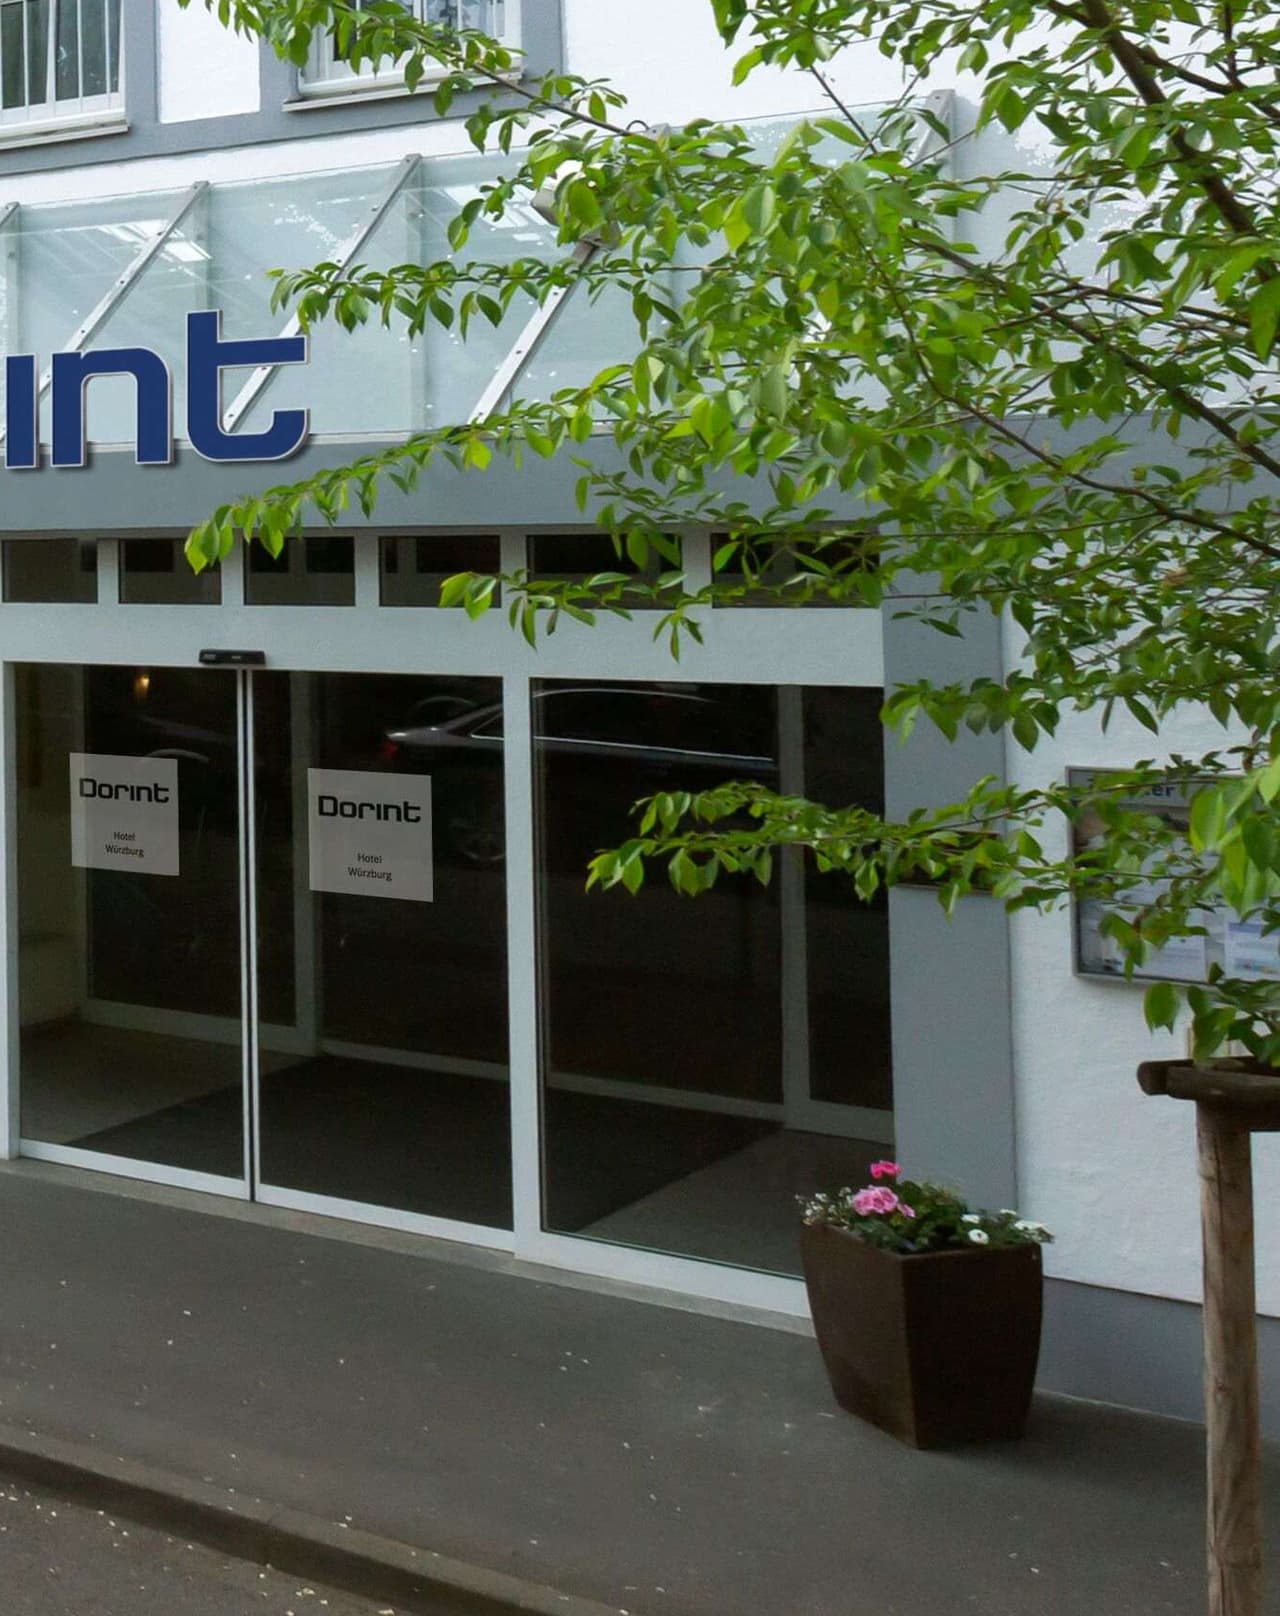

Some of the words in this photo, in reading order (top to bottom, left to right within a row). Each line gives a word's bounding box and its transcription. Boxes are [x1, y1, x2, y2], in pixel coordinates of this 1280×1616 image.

[79, 777, 170, 803] Dorint
[318, 795, 422, 823] Dorint
[113, 831, 136, 841] Hotel
[105, 844, 145, 858] Würzburg
[357, 853, 383, 864] Hotel
[347, 867, 393, 882] Würzburg
